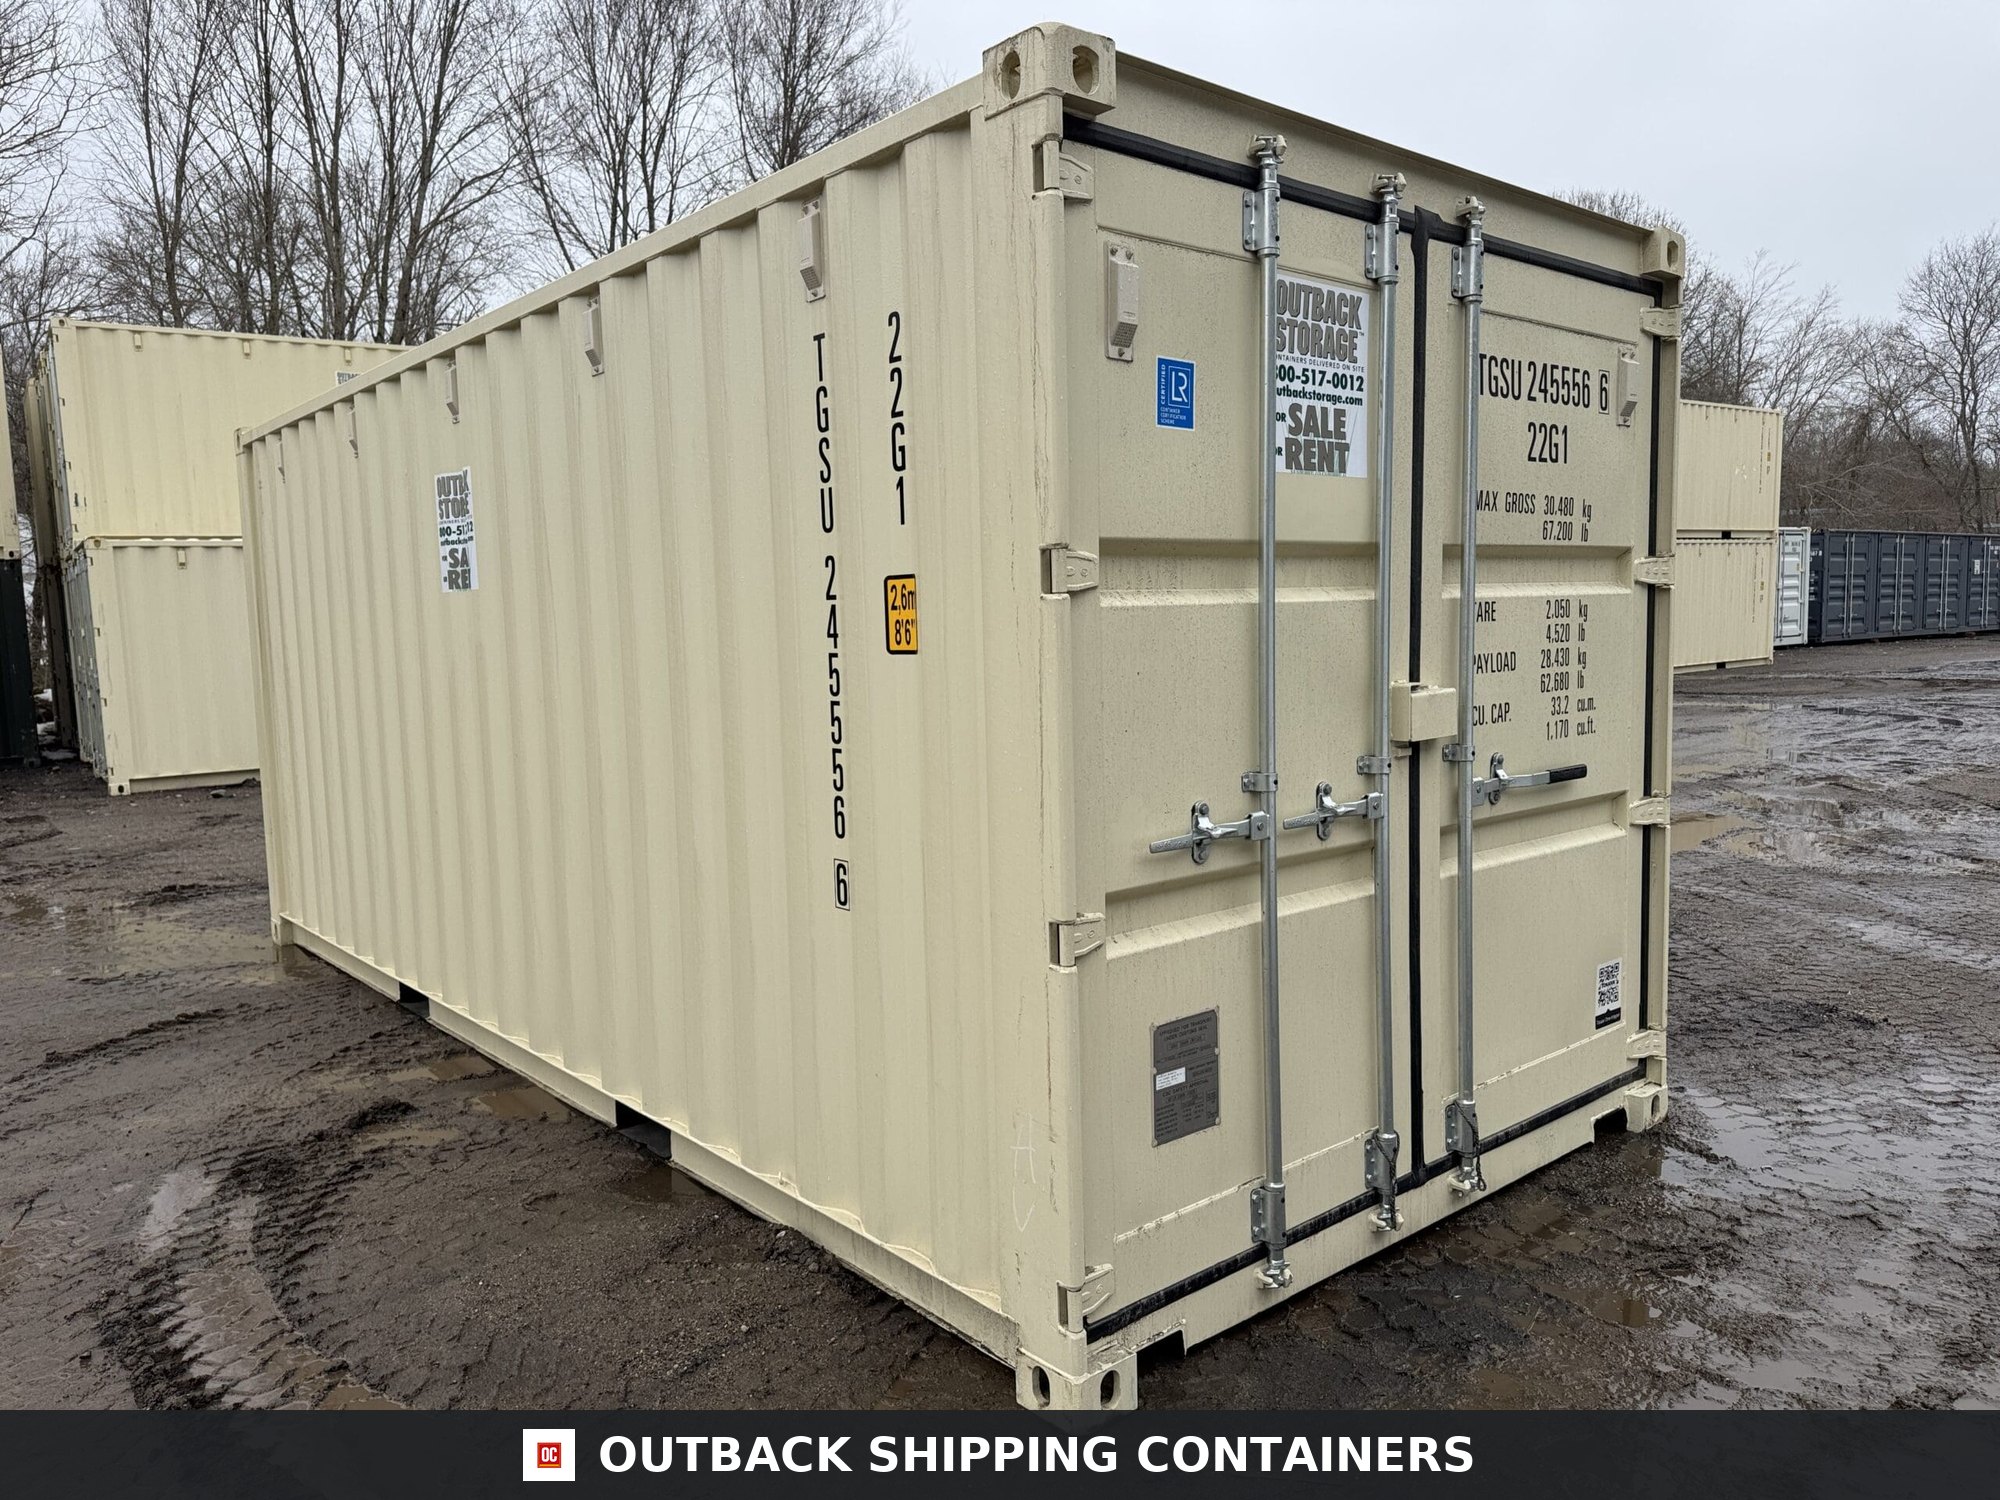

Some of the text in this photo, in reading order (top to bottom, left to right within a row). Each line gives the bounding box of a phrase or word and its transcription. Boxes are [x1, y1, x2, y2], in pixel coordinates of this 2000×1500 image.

[1277, 279, 1362, 330] OUTBACK
[1276, 316, 1358, 364] STORAGE
[1276, 354, 1307, 364] NTAINERS
[1309, 359, 1341, 369] DELIVERED
[1172, 371, 1188, 403] LR
[1277, 384, 1363, 406] utbackstorage.com
[1479, 353, 1608, 411] TGSU 245556 6
[888, 311, 906, 525] 22G1
[1275, 403, 1346, 440] OR SALE
[1284, 437, 1350, 474] RENT
[1528, 422, 1568, 464] 22G1
[1476, 490, 1499, 512] MAX
[1505, 491, 1536, 515] GROSS
[1582, 498, 1592, 523] kg
[1581, 522, 1589, 542] lb
[813, 332, 848, 906] TGSU 245556 6
[1475, 601, 1496, 622] ARE
[1578, 598, 1588, 623] kg
[1578, 622, 1585, 642] lb
[1577, 646, 1587, 670] kg
[1577, 669, 1584, 689] lb
[1473, 695, 1596, 726] CU. CAP. 33.2 cu.m.
[1577, 715, 1596, 736] cu.ft.
